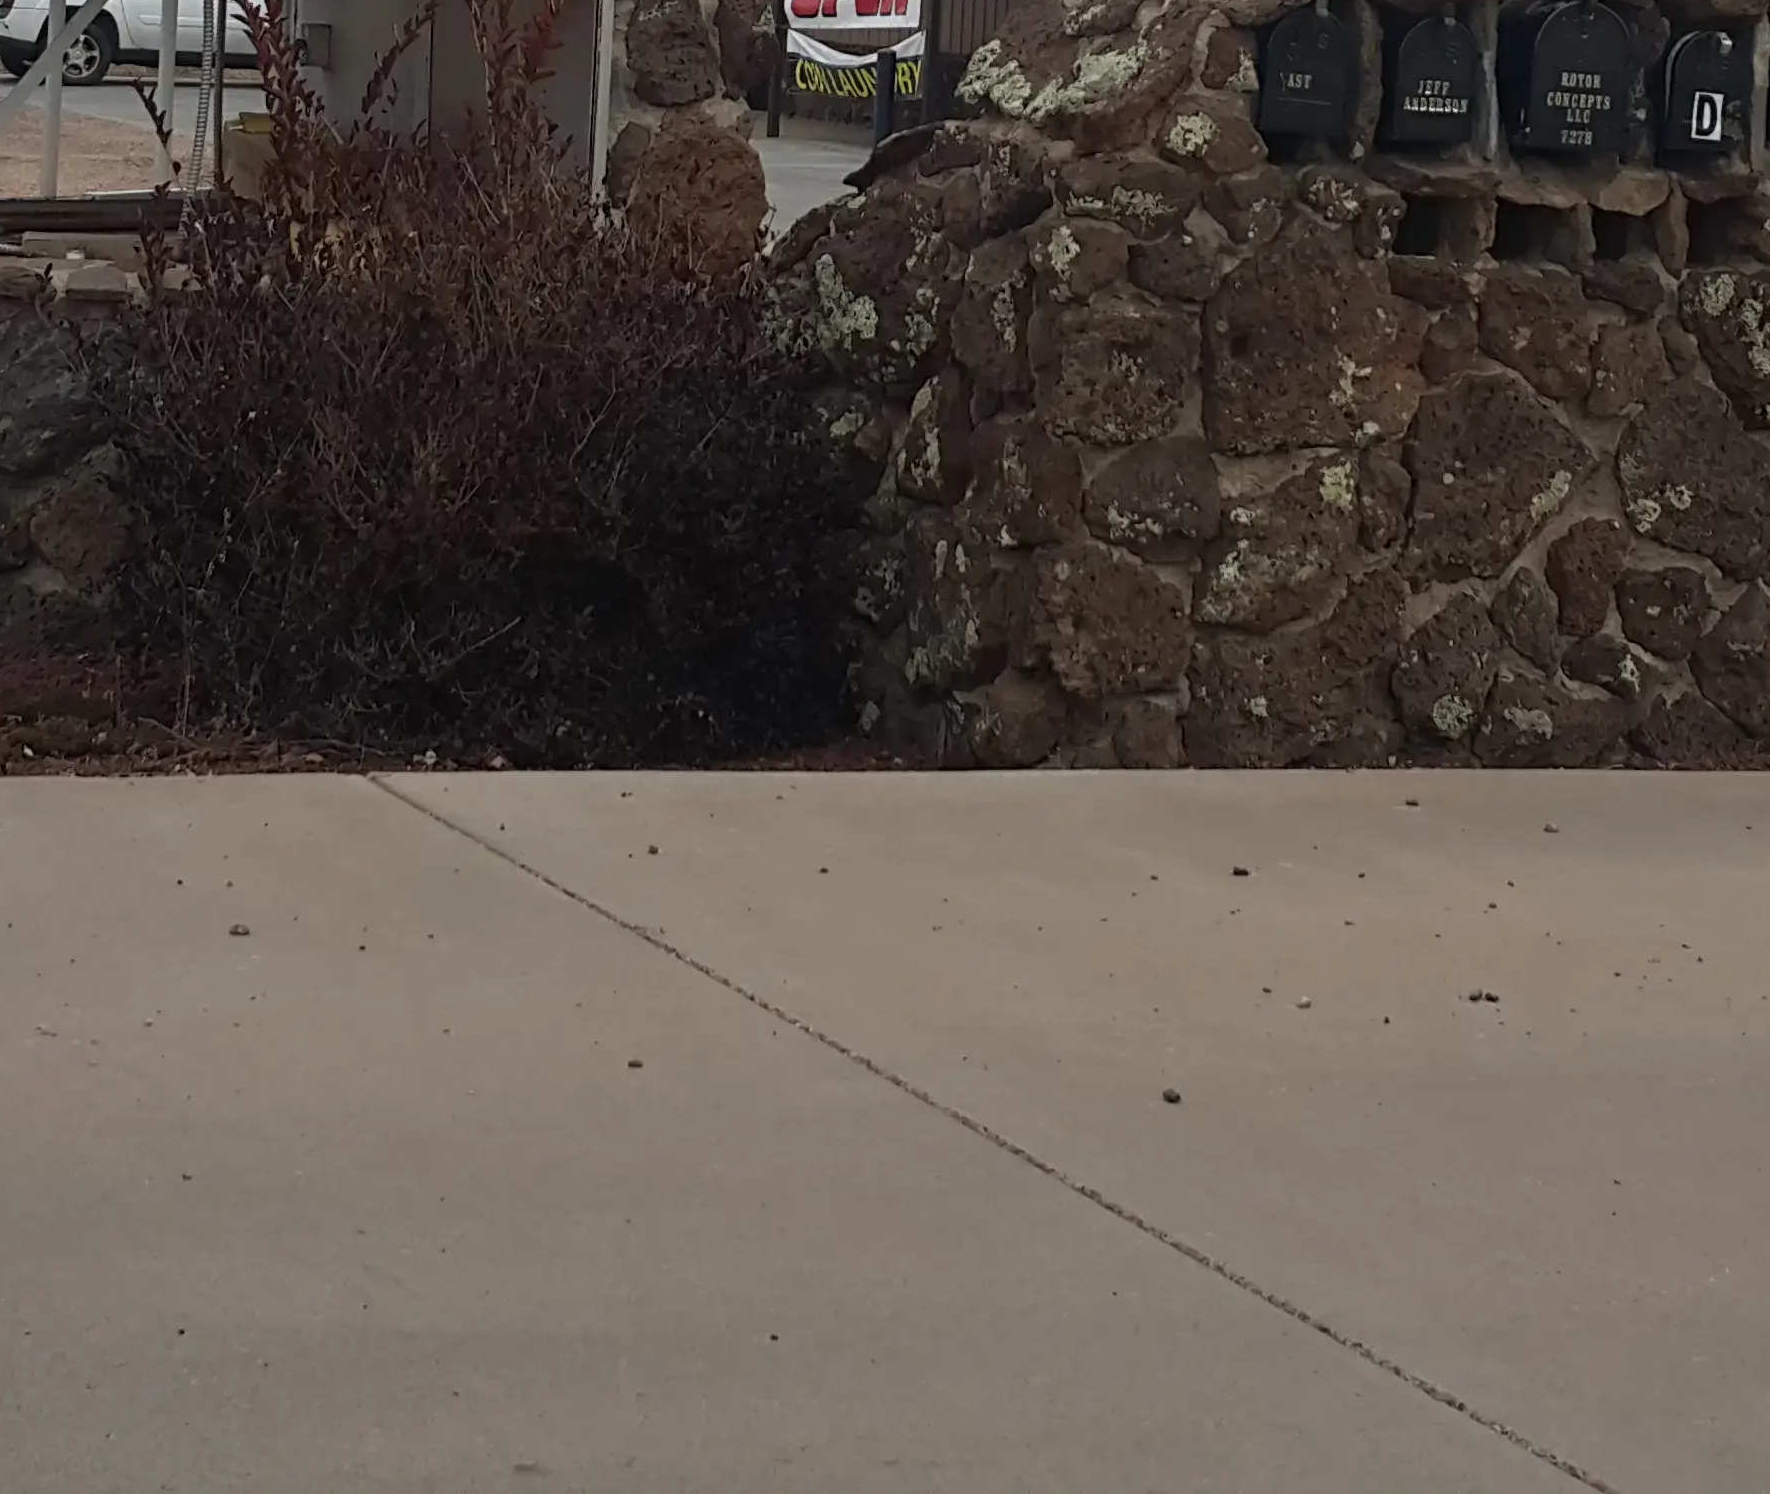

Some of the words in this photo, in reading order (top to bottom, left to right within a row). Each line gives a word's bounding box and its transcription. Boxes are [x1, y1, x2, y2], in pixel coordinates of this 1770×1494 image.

[795, 57, 832, 95] COIN
[827, 59, 922, 98] LAUNRY
[1560, 71, 1602, 89] ROTOR
[1417, 80, 1451, 96] JEFF
[1402, 95, 1469, 114] ANDERSON
[1545, 90, 1612, 111] CONCEPTS
[1566, 108, 1591, 124] LLC
[1695, 94, 1718, 137] D
